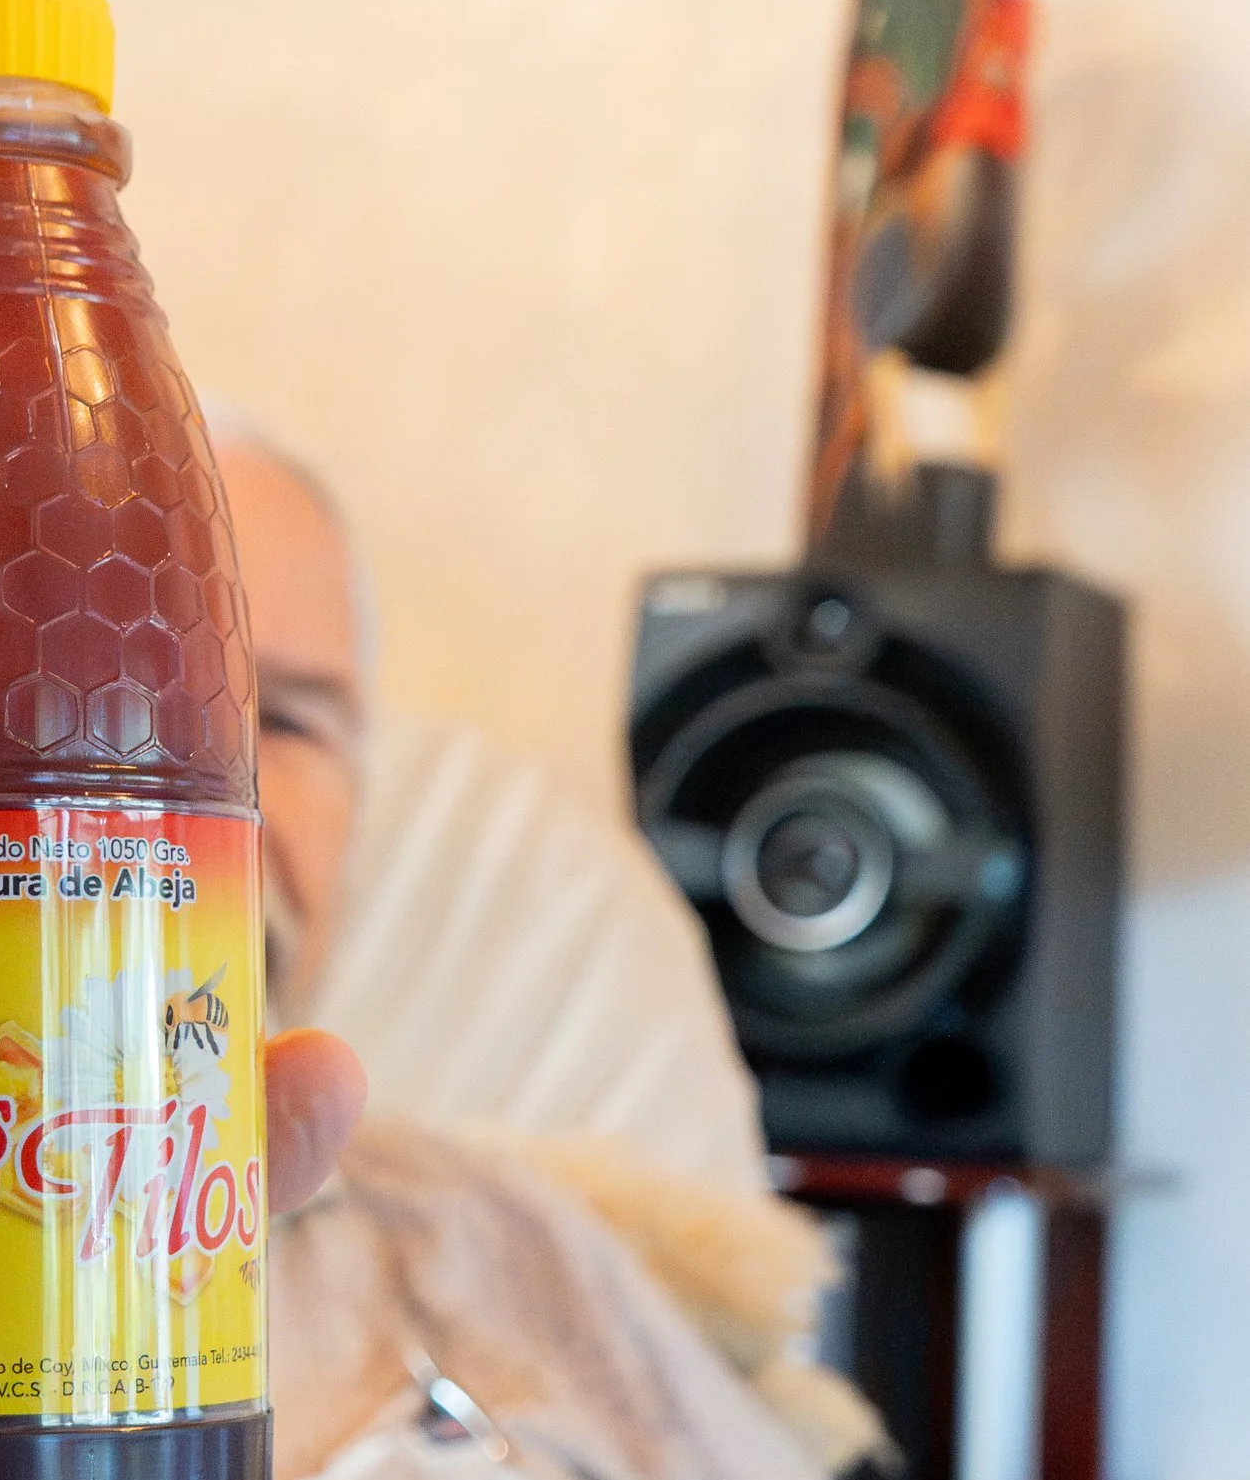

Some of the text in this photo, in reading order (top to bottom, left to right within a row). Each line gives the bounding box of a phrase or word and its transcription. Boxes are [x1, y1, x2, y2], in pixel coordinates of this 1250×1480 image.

[31, 836, 90, 859] Neto
[98, 838, 148, 860] 1050
[153, 839, 190, 863] Grs.
[59, 865, 103, 898] de
[112, 866, 196, 908] Abeja
[18, 1099, 260, 1261] Tilos
[11, 1356, 34, 1375] de
[137, 1351, 208, 1371] Guemala
